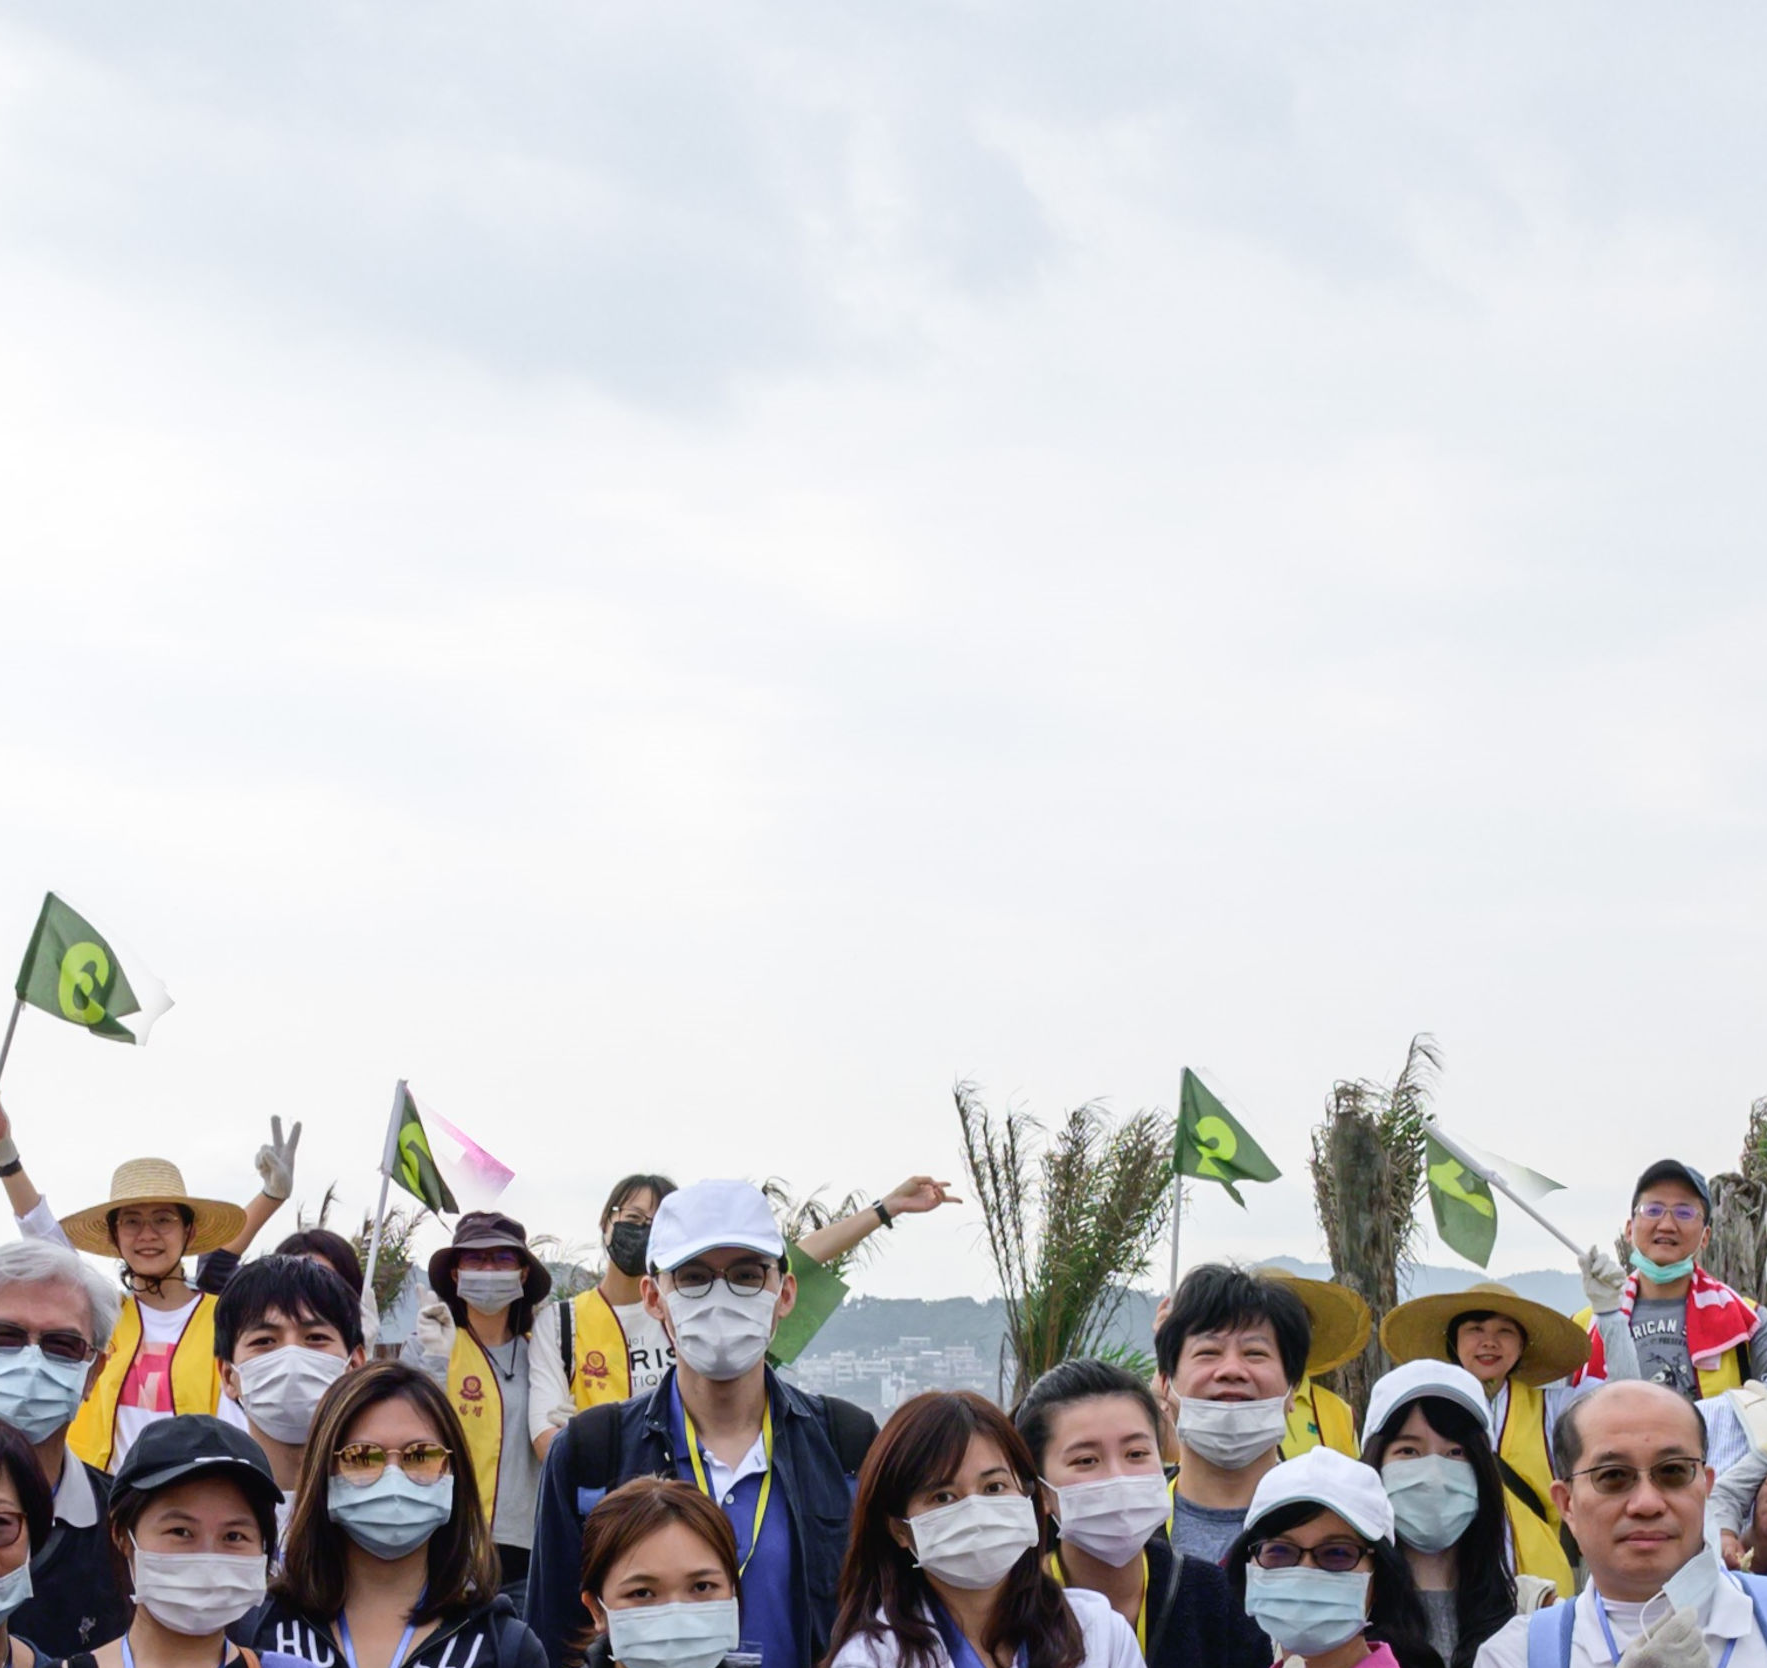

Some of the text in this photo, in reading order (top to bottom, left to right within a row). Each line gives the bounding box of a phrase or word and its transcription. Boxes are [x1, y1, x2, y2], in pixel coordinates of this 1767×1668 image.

[1633, 1319, 1678, 1339] RICAN
[630, 1346, 676, 1371] RIS
[633, 1373, 663, 1388] TIQ
